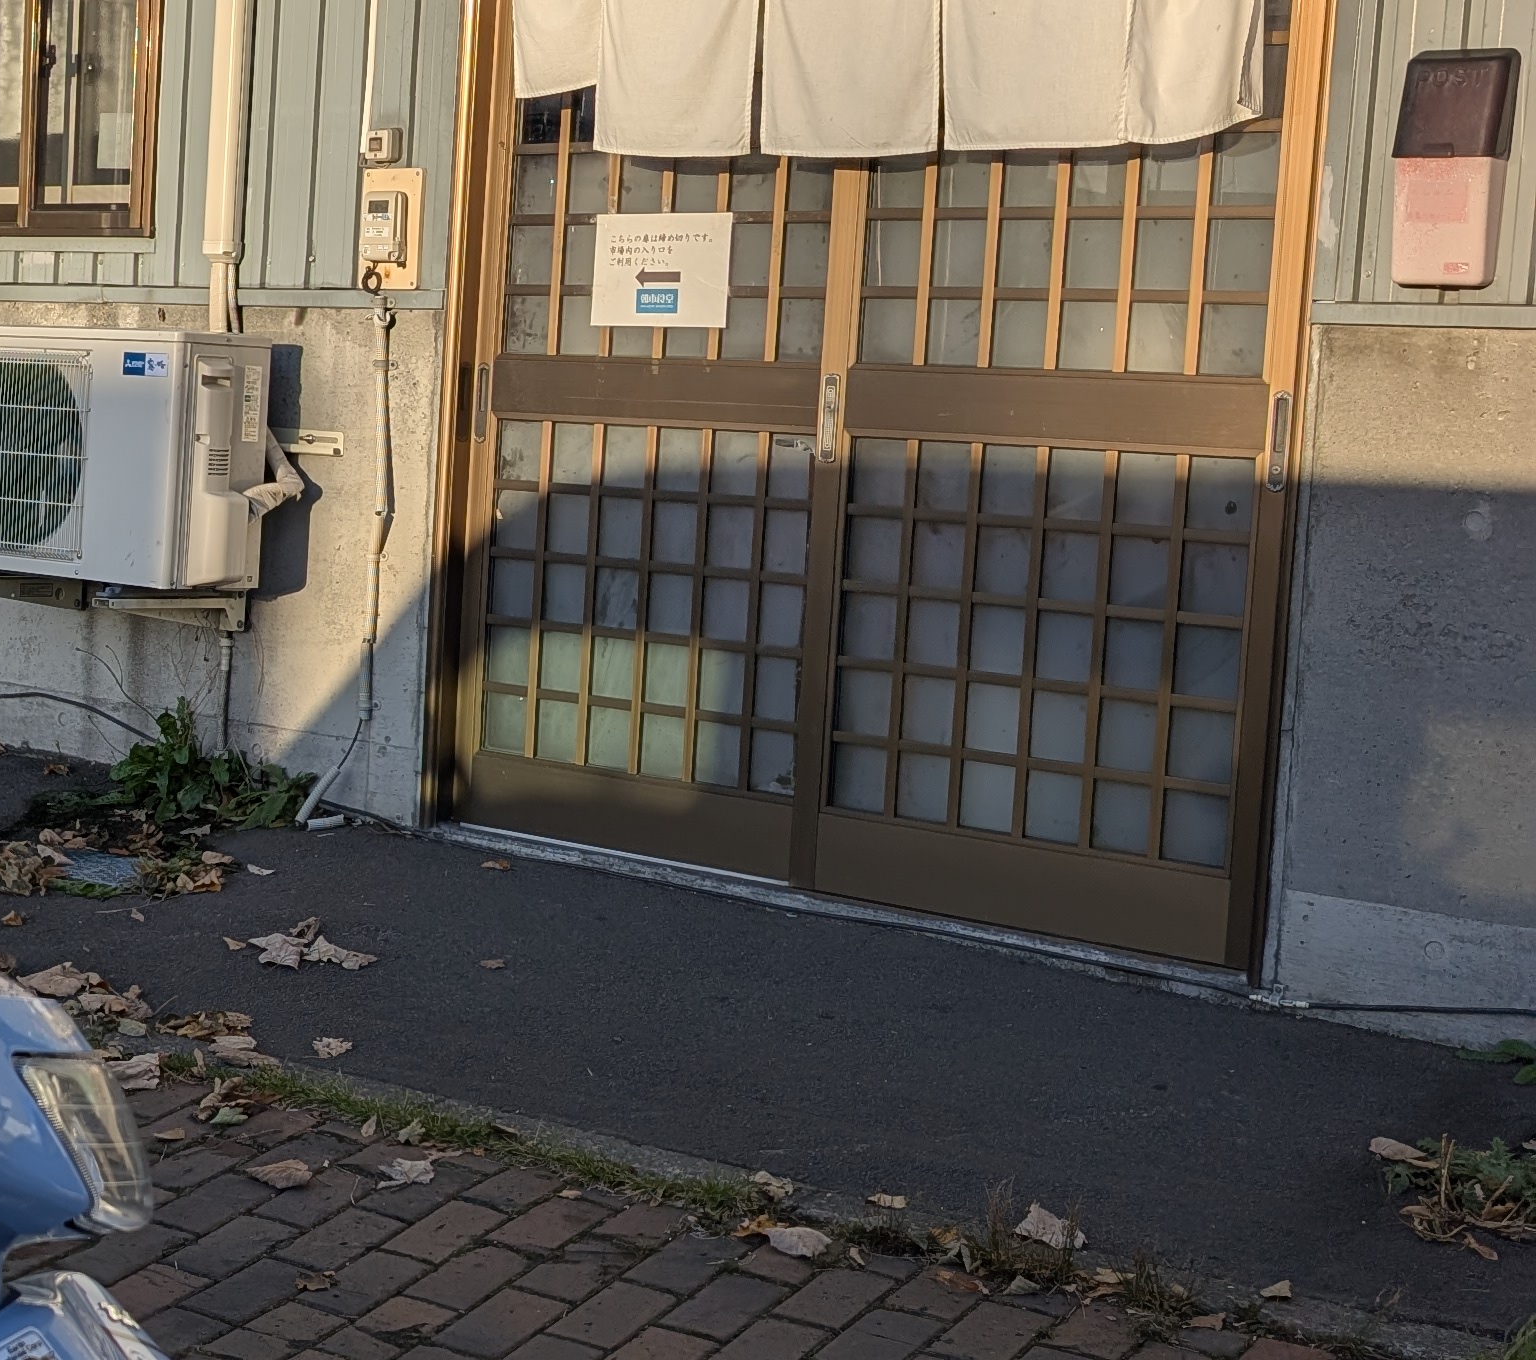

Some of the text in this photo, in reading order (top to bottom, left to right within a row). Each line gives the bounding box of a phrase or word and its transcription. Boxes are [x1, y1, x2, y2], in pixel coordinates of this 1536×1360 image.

[1415, 66, 1489, 89] POST
[608, 257, 670, 267] ご利用ください。
